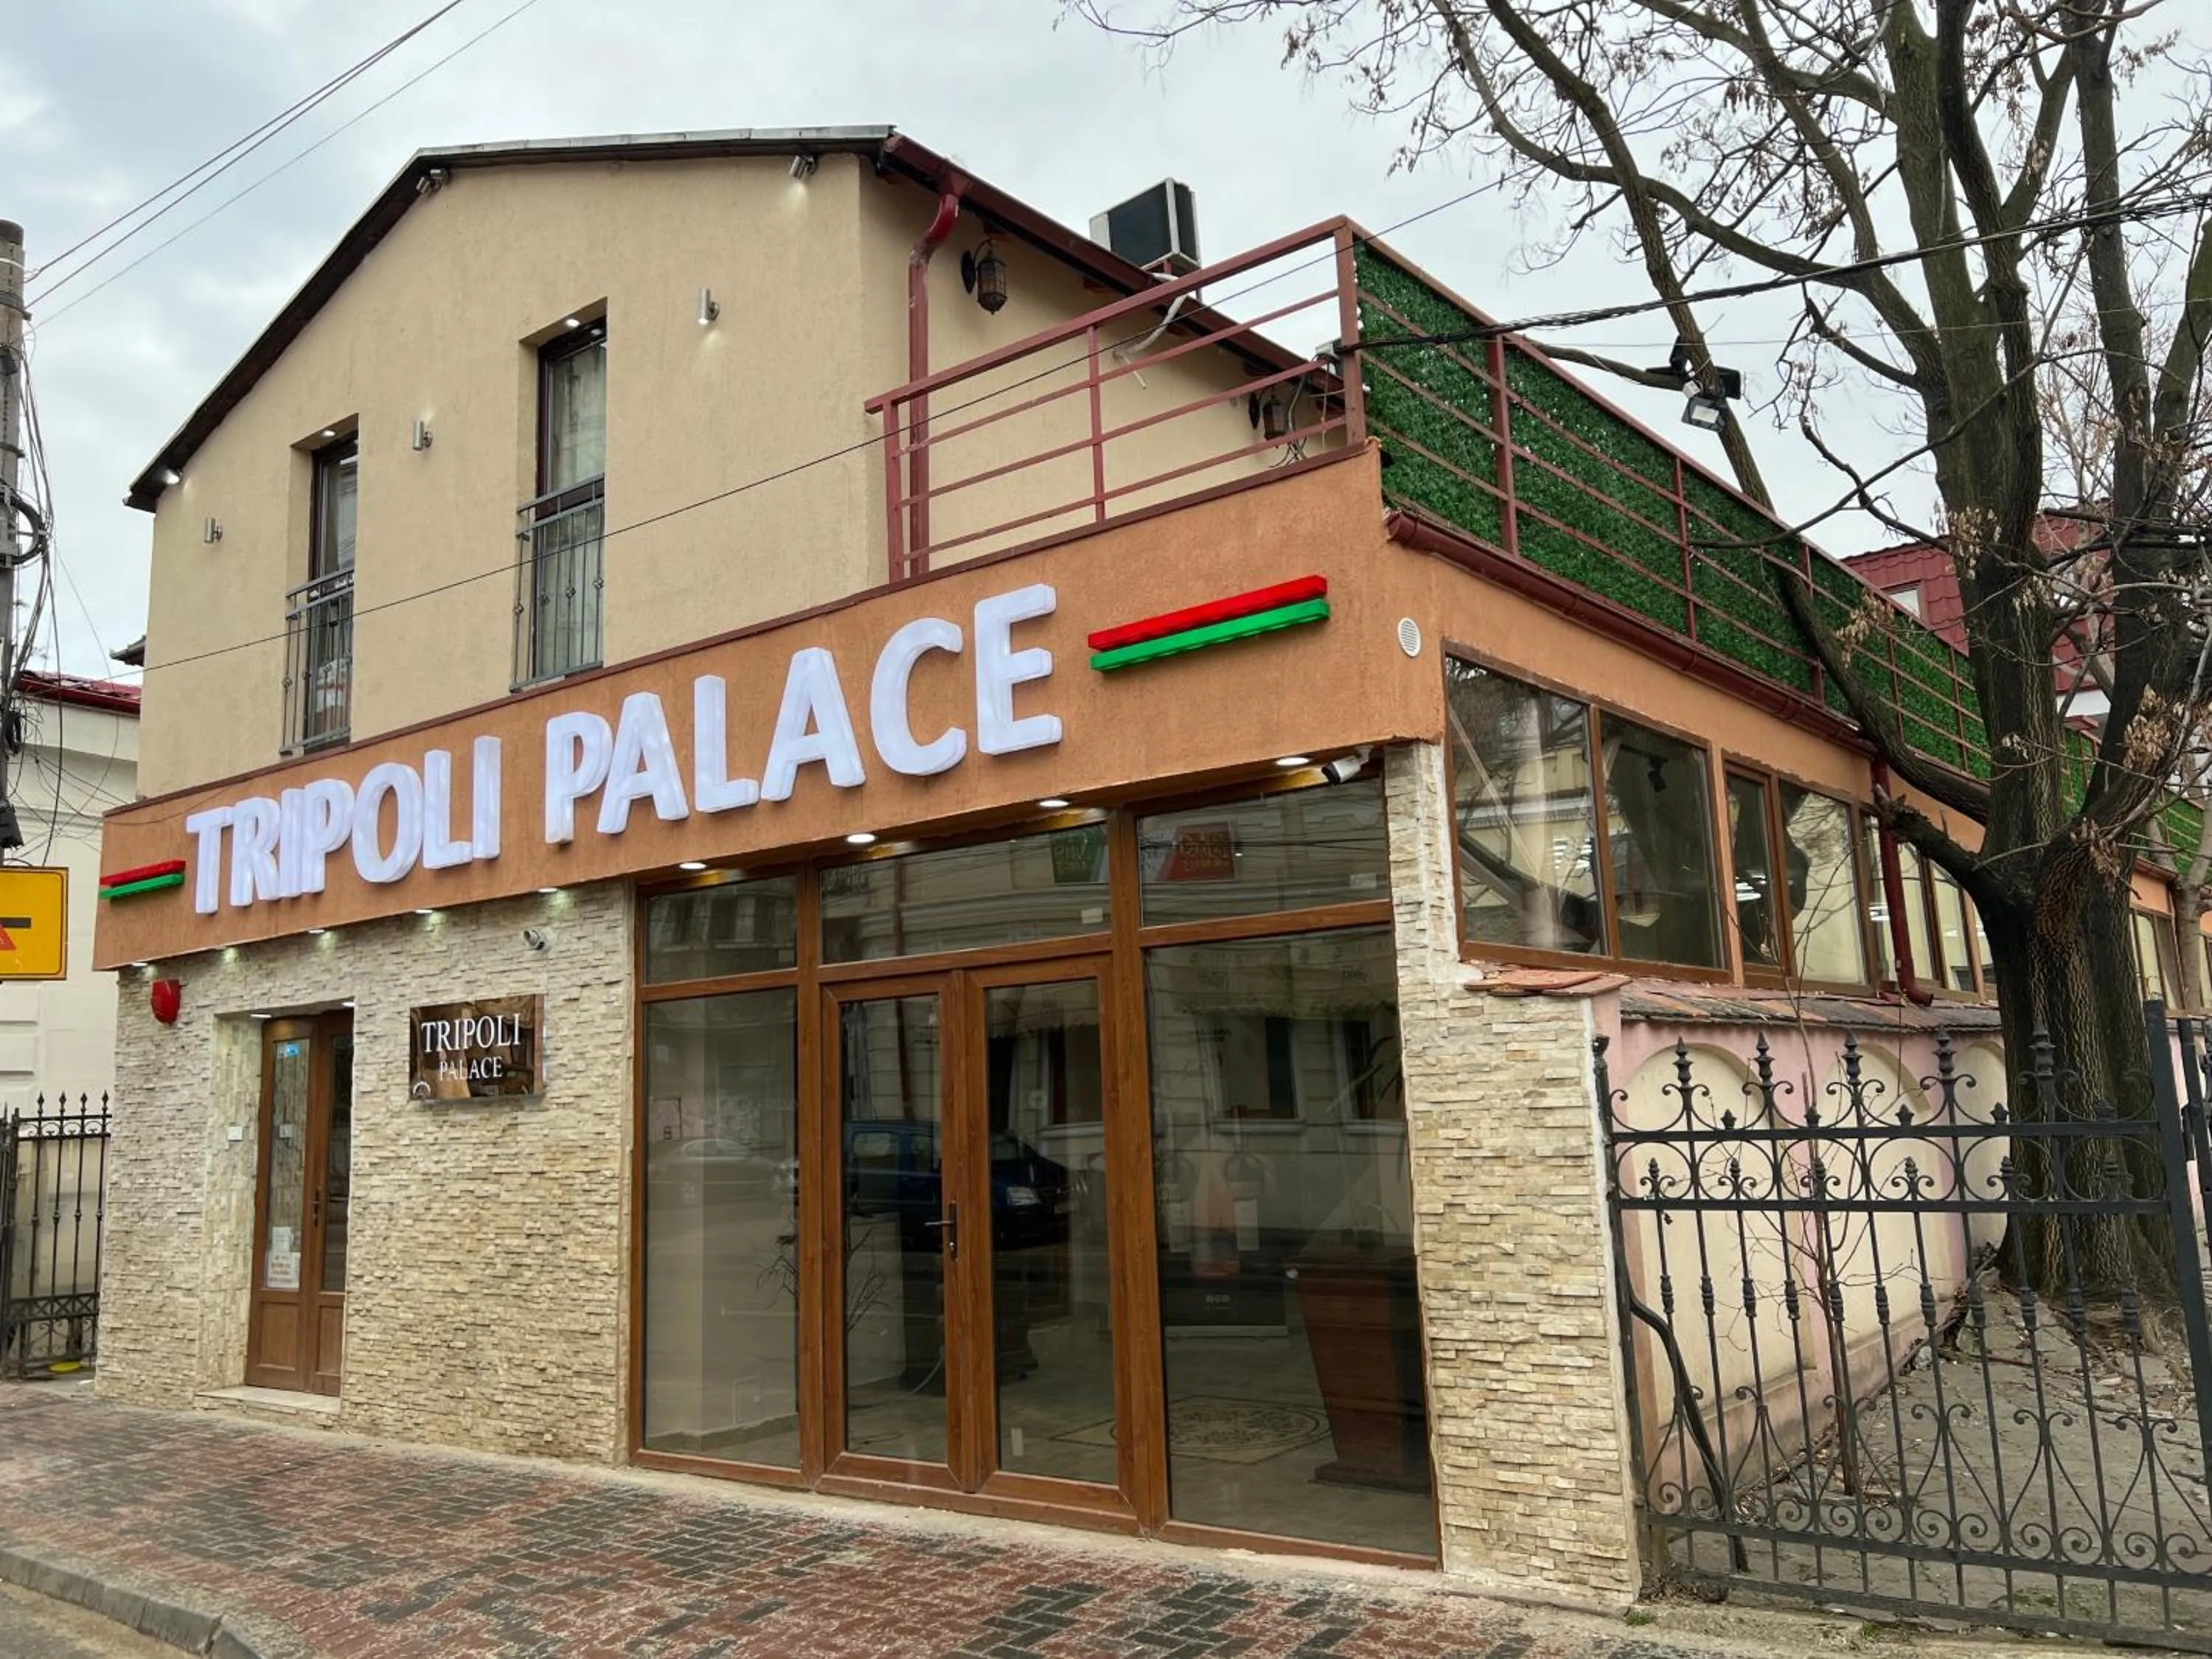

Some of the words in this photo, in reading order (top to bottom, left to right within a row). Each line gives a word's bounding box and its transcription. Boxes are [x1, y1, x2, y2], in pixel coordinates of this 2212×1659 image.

[186, 735, 503, 915] TRIPOLI
[544, 582, 1062, 844] PALACE
[421, 1013, 521, 1053] TRIPOLI
[439, 1056, 503, 1081] PALACE
